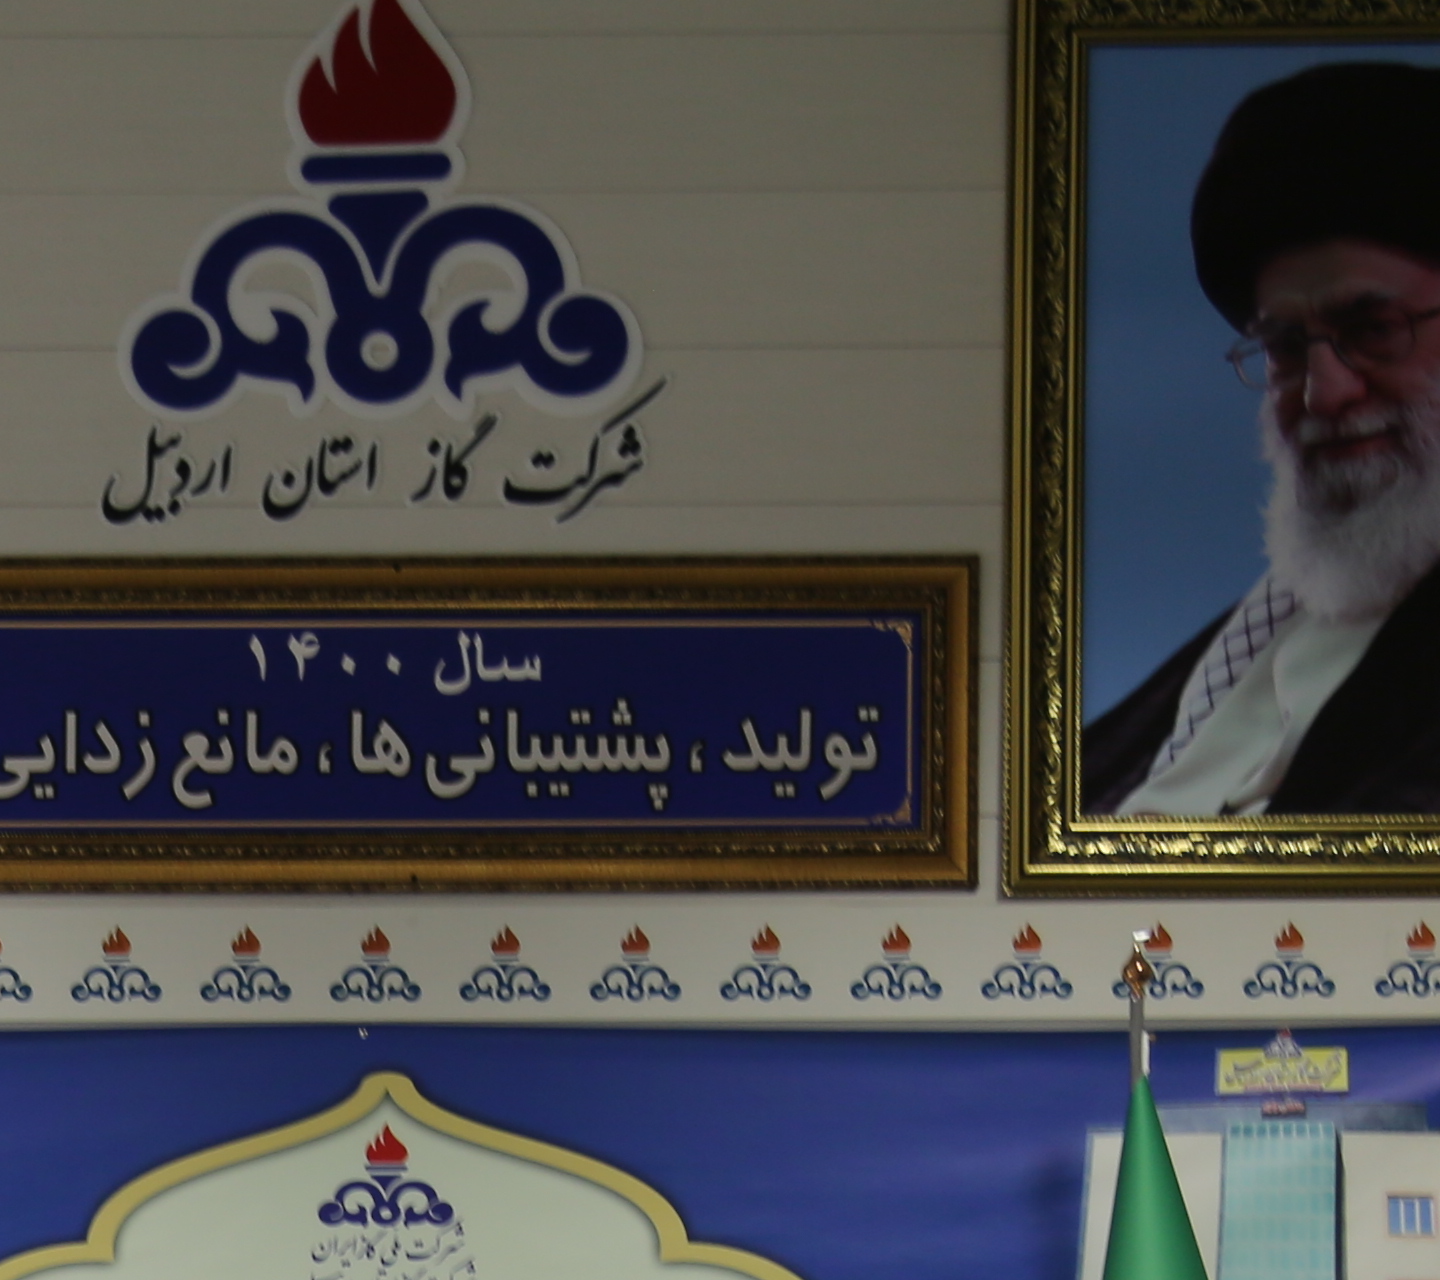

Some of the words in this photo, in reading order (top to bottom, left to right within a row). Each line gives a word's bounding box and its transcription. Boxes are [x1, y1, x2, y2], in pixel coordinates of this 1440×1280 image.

[100, 424, 233, 525] اردبیل
[261, 433, 379, 523] استان
[410, 412, 498, 502] گاز
[503, 376, 667, 525] شرکت
[248, 631, 403, 683] ۱۴۰۰
[433, 629, 543, 697] سال
